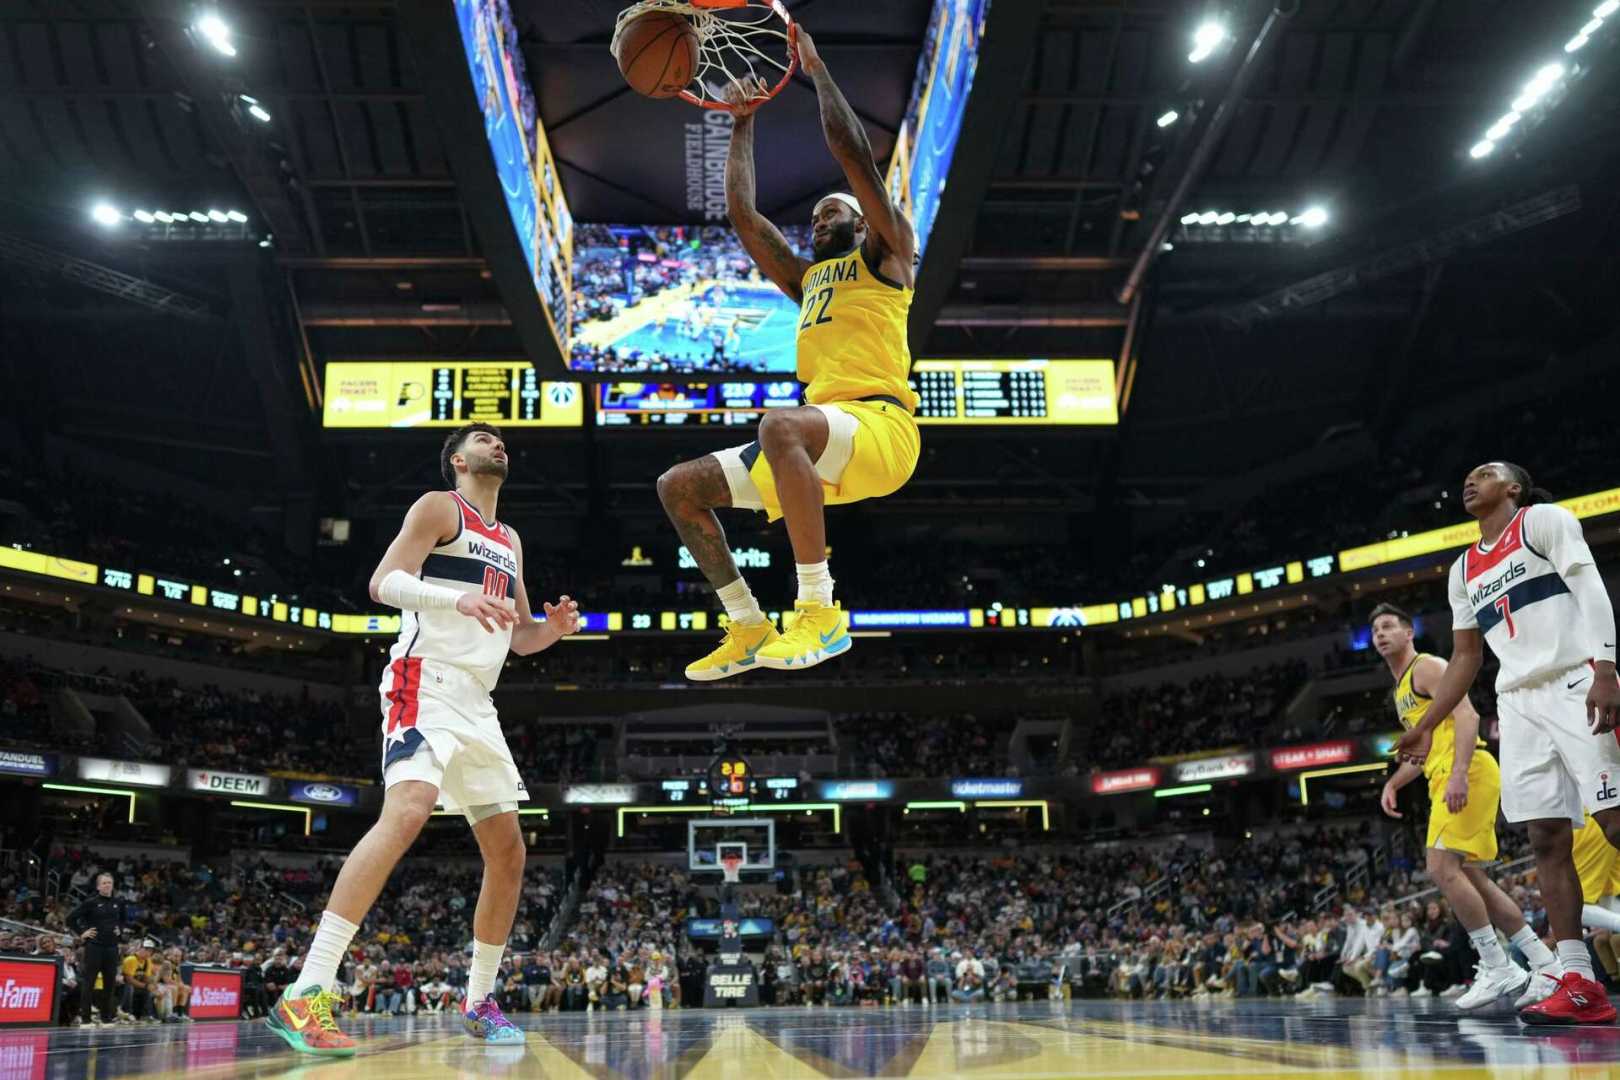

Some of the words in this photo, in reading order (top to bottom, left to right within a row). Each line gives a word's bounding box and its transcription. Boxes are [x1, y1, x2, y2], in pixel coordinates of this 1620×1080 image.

[685, 123, 704, 210] FIELDHOUSE
[803, 260, 858, 294] NDIANA
[800, 287, 834, 330] 22
[468, 541, 517, 573] Wizards
[483, 565, 509, 601] 00
[1470, 560, 1527, 607] Wizards
[1494, 594, 1518, 640] 7
[210, 774, 260, 792] DEEM
[710, 974, 753, 986] BELLE
[714, 986, 747, 998] TIRE
